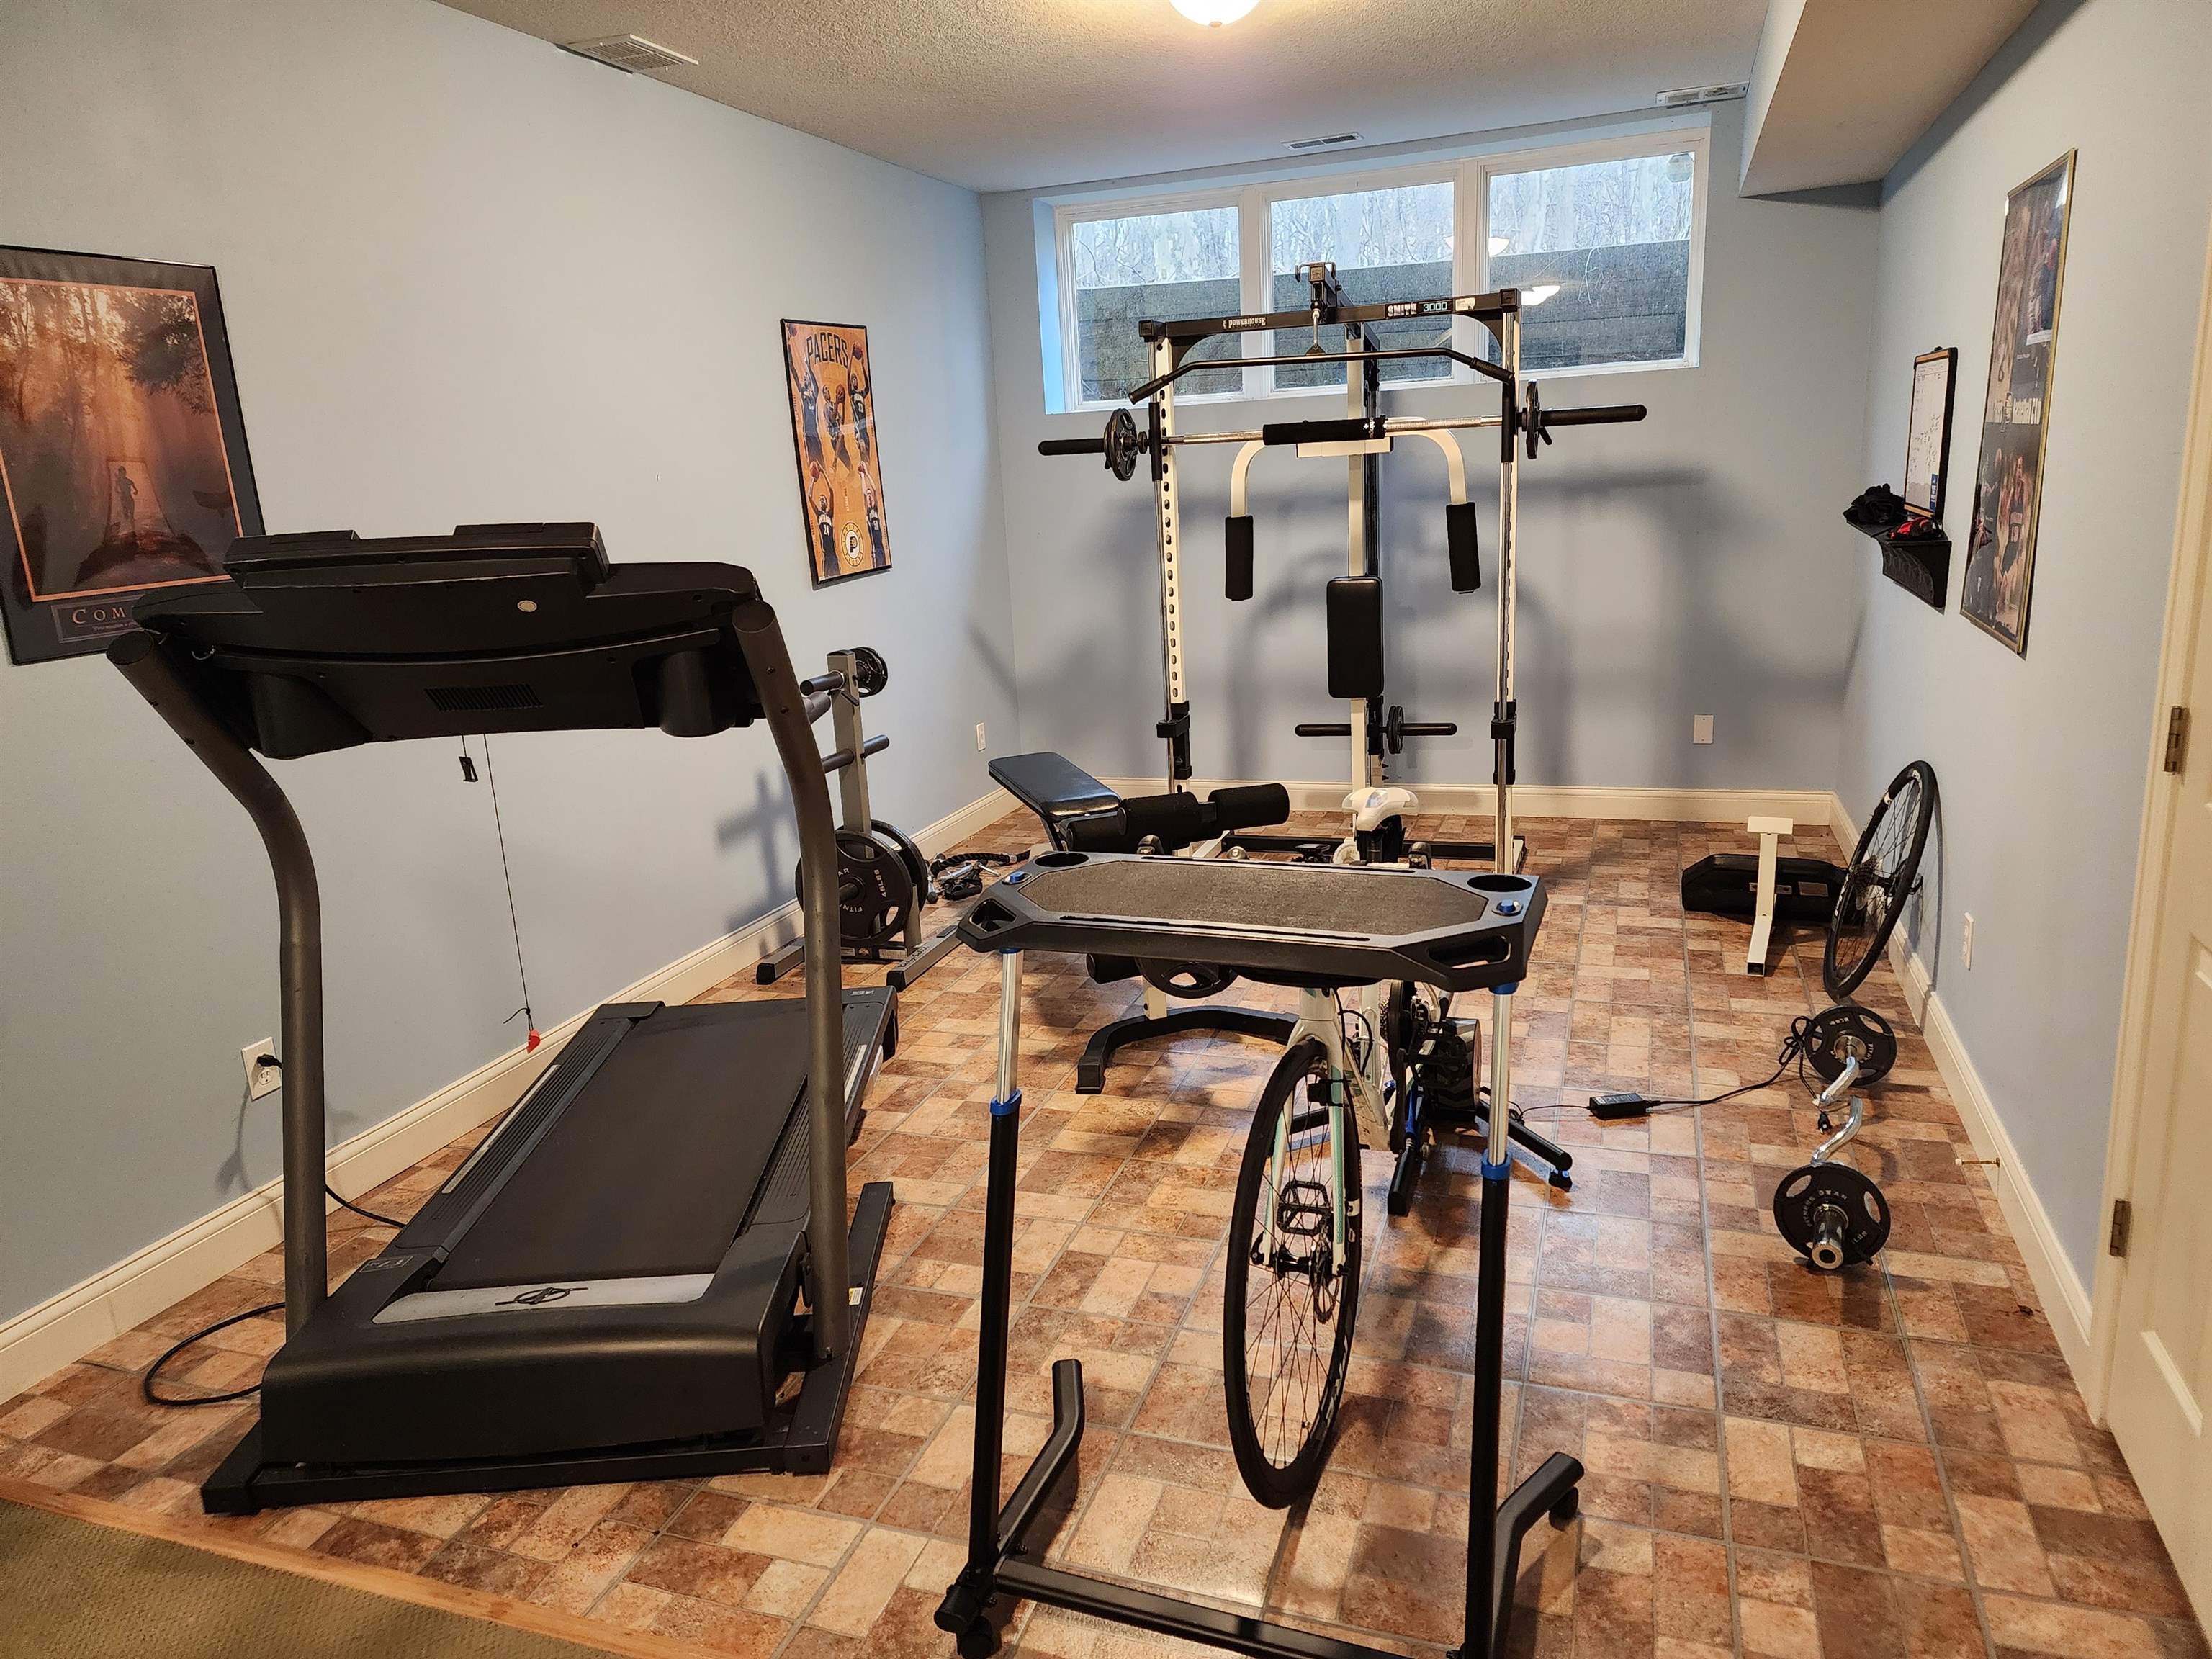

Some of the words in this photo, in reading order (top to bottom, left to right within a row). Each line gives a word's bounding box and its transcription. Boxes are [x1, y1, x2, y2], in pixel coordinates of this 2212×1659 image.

[1387, 303, 1417, 317] SMITH
[1423, 302, 1448, 312] 3000
[1228, 317, 1266, 329] POWERHOUSE
[806, 332, 848, 369] PACERS
[73, 607, 126, 624] COM
[840, 904, 863, 912] FITN
